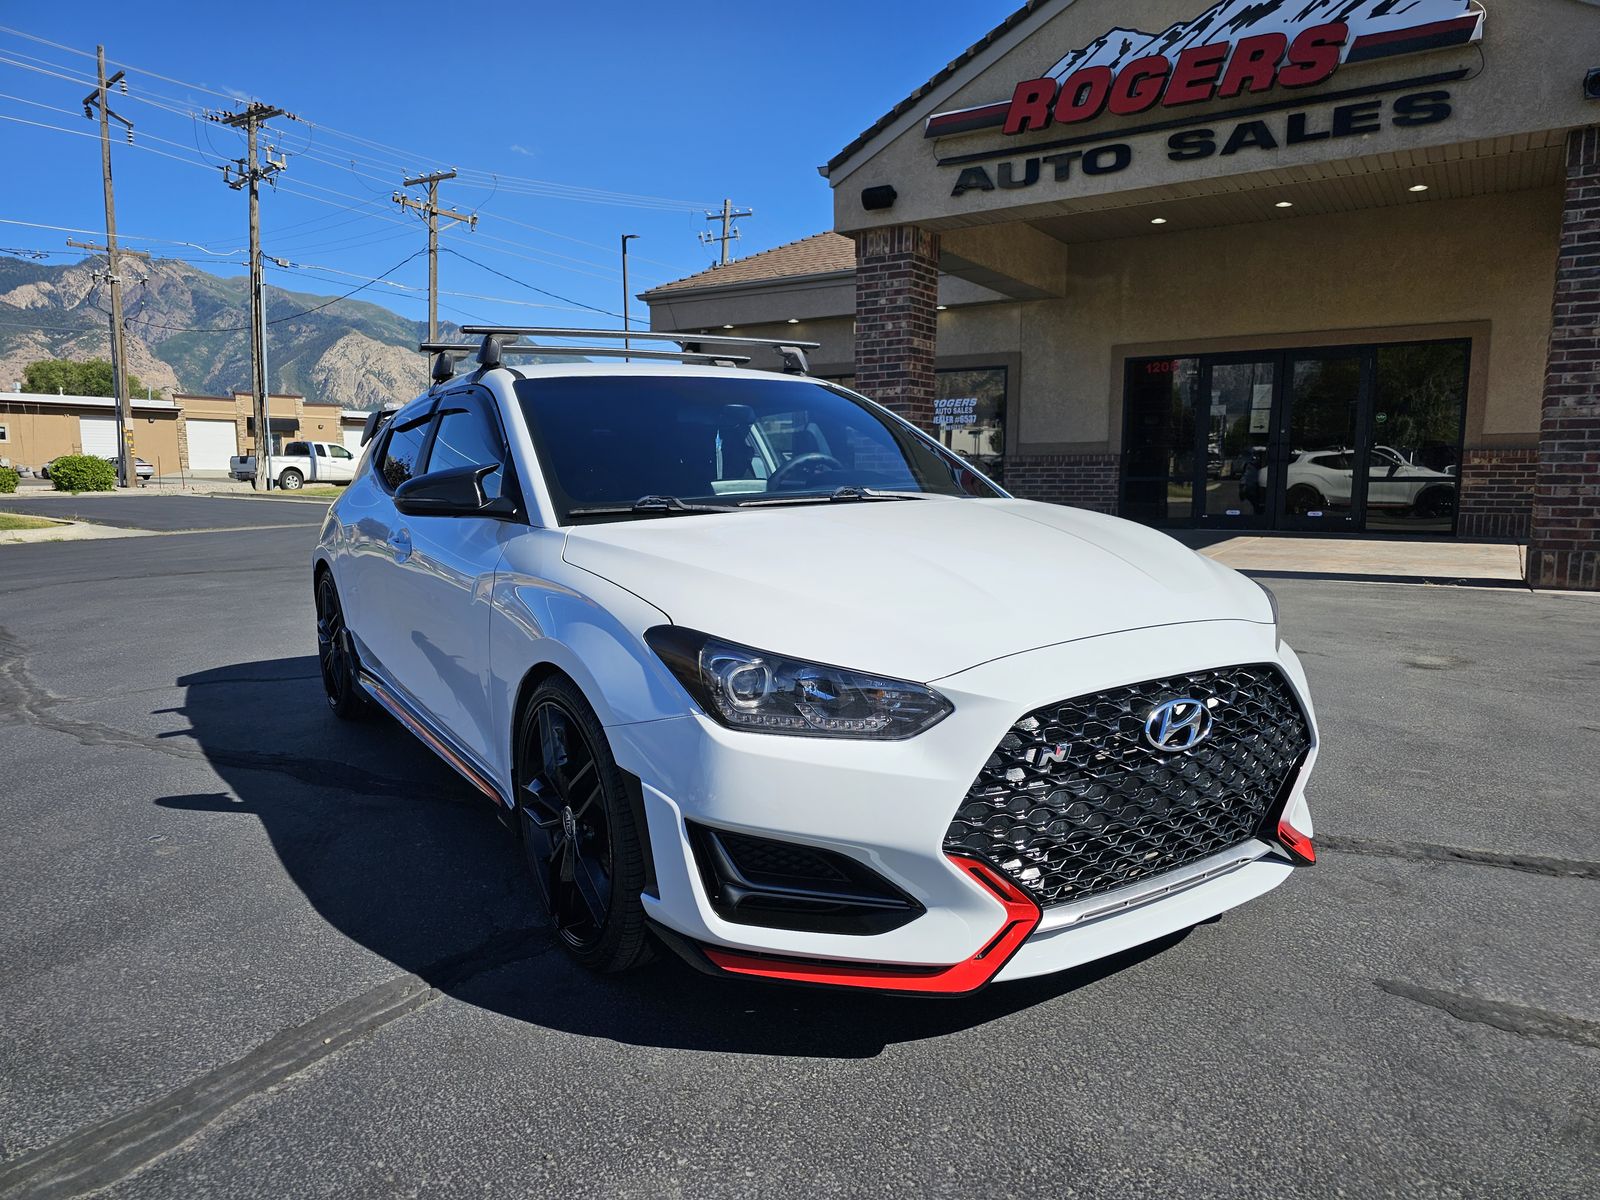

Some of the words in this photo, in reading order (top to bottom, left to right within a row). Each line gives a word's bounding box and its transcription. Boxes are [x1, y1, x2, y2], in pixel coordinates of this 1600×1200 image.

[1002, 22, 1349, 135] ROGERS
[951, 143, 1132, 197] AUTO
[1167, 90, 1452, 162] SALES
[935, 407, 952, 415] AUTO
